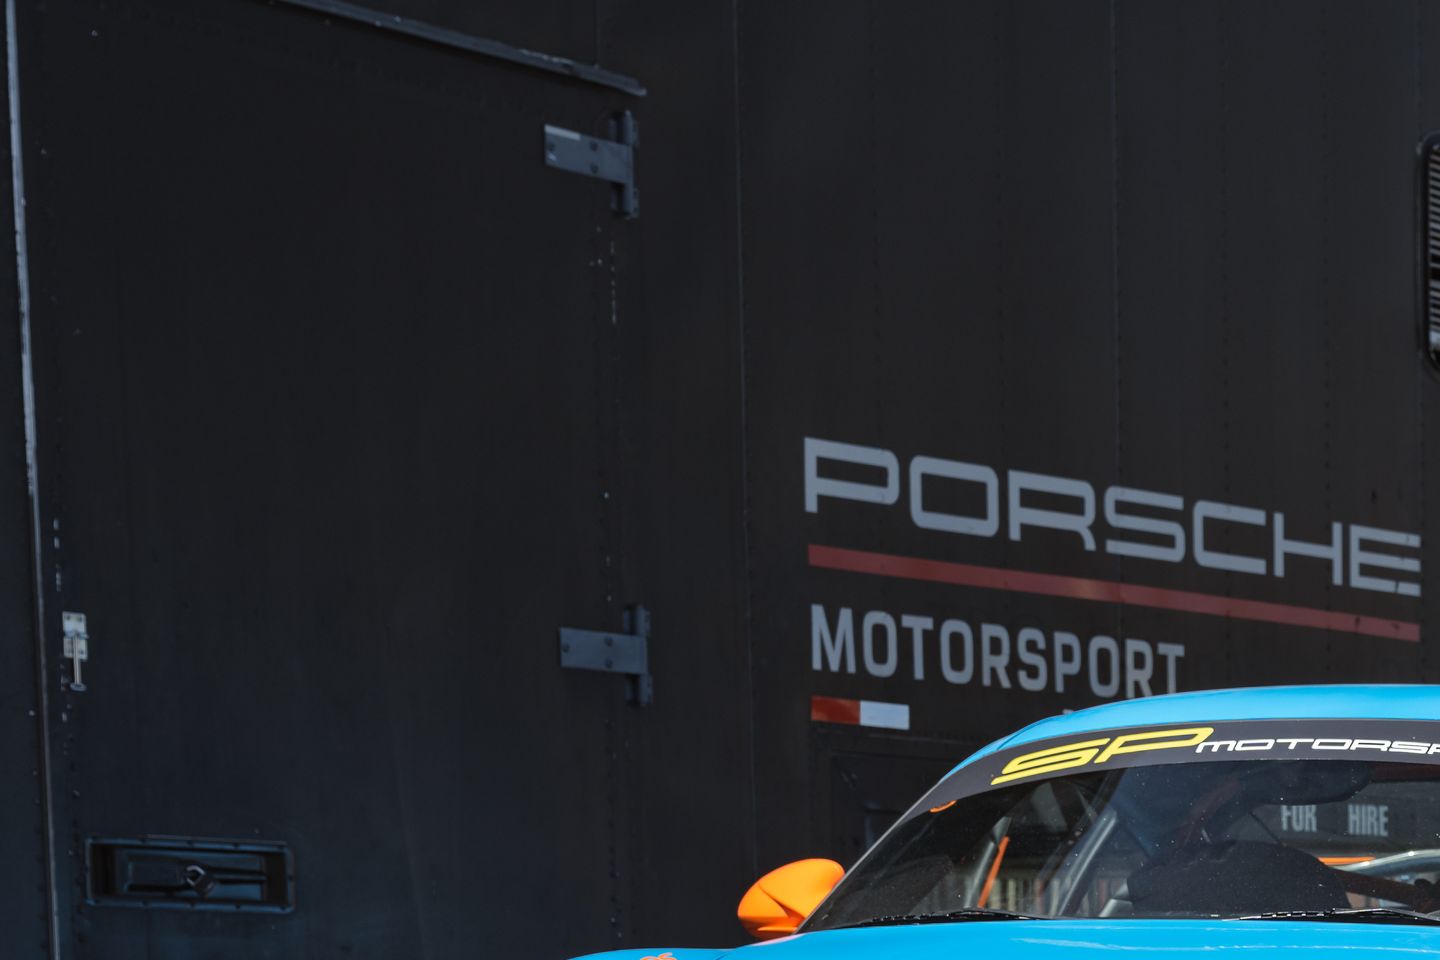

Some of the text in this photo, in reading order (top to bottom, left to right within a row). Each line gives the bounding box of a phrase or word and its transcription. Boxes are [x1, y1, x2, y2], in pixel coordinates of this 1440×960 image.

[804, 437, 1421, 597] PORSCHE
[810, 604, 1186, 696] MOTORSPORT
[990, 727, 1214, 786] SP
[1347, 803, 1389, 837] HIRE
